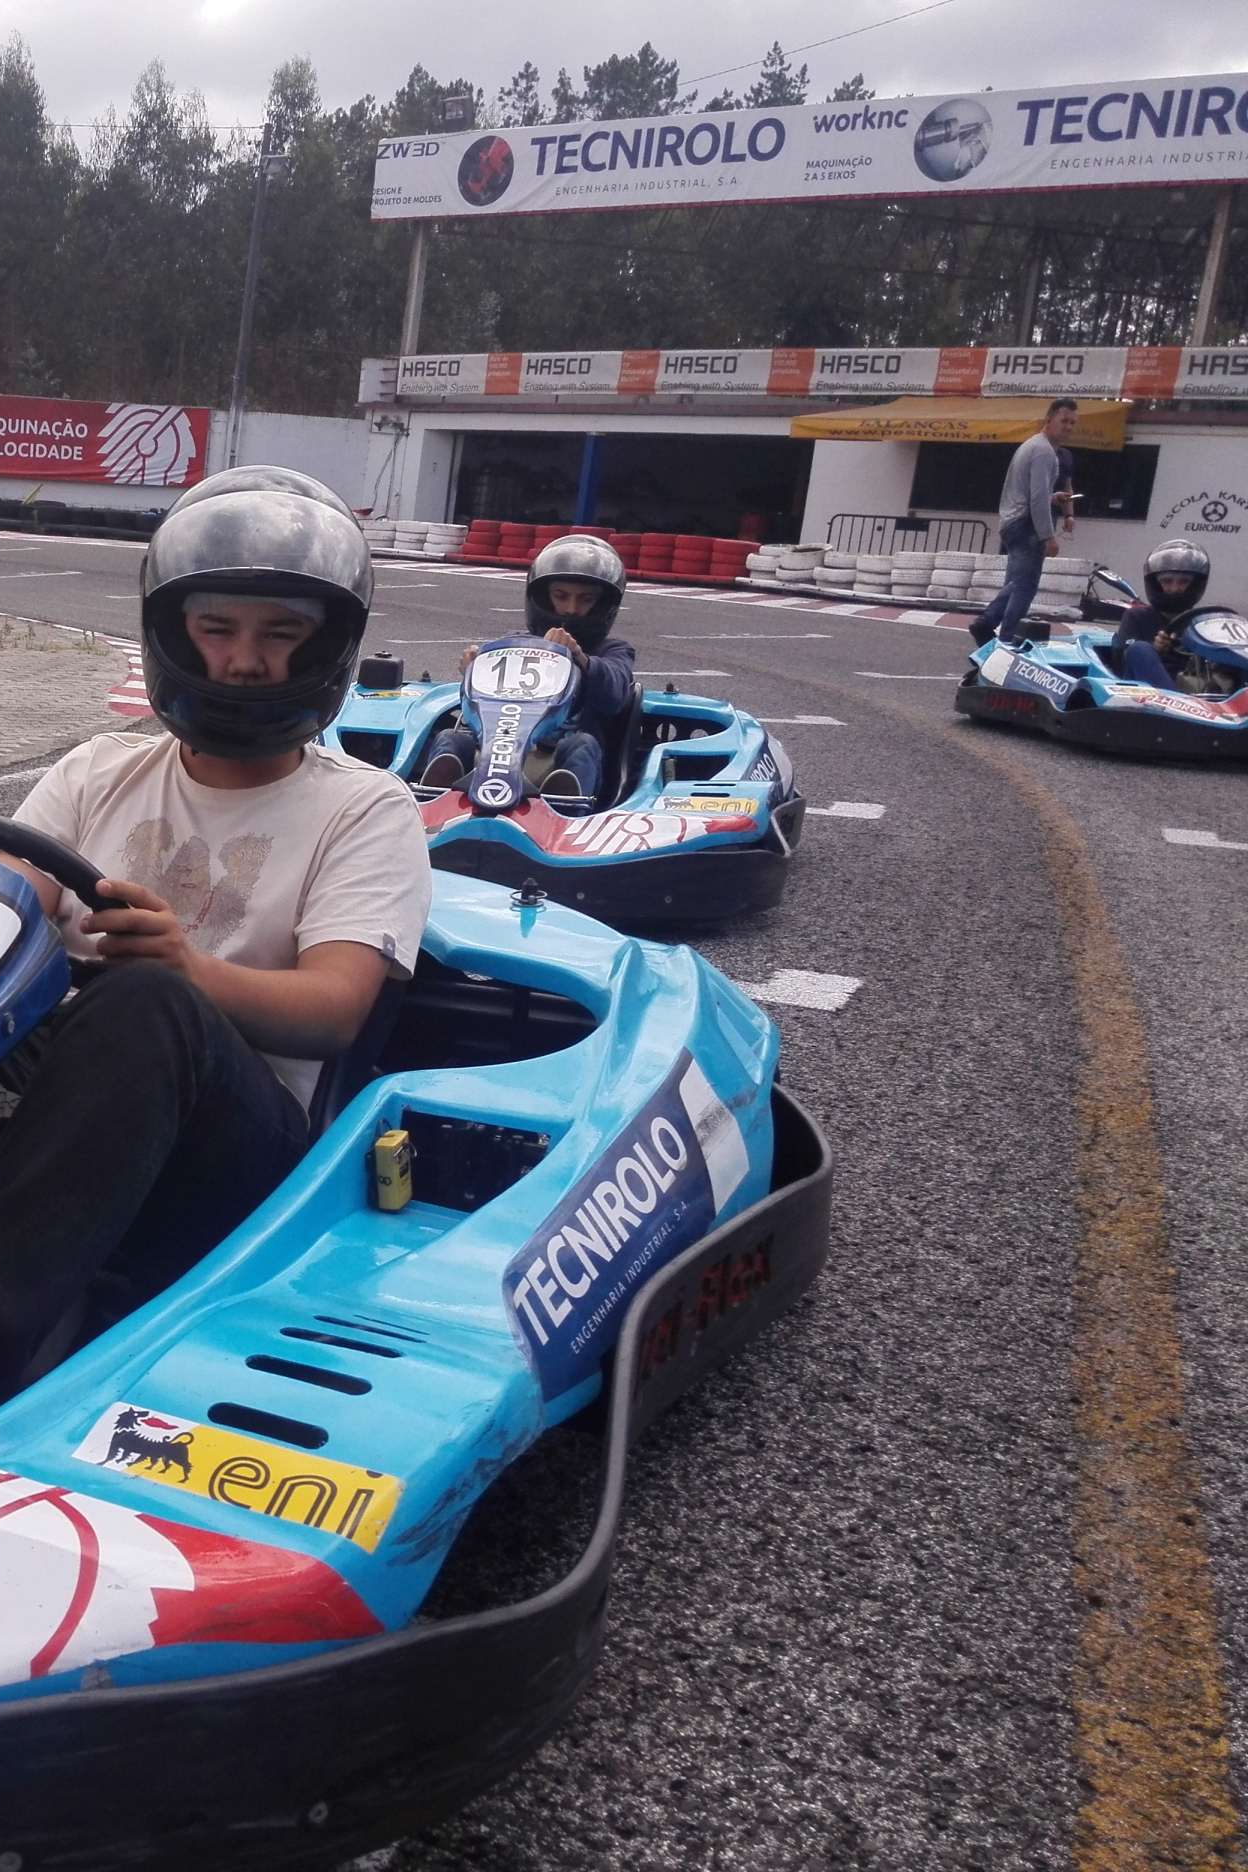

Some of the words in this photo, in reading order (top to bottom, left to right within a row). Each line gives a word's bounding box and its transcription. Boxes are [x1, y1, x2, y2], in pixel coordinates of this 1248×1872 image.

[813, 105, 909, 133] worknc
[530, 118, 786, 176] TECNIROLO
[805, 155, 873, 170] MAQUINAÇÃO
[1050, 155, 1153, 169] ENGENHARIA
[1162, 151, 1248, 165] INDUSTRI
[804, 172, 811, 181] 2
[811, 172, 818, 181] A
[827, 170, 857, 180] EIXOS
[413, 194, 443, 204] MOLDES
[555, 183, 629, 196] ENGENHARIA
[402, 360, 461, 377] HASCO
[526, 358, 592, 375] HASCO
[664, 356, 738, 374] HASCO
[820, 355, 902, 374] HASCO
[992, 354, 1084, 375] HASCO
[1160, 491, 1209, 529] ESCOLA
[1184, 522, 1242, 534] EUROINDY
[487, 649, 559, 660] EUROINDY
[491, 656, 541, 695] 15
[1014, 660, 1070, 696] TECNIROLO
[487, 704, 522, 777] TECNIROLO
[512, 1116, 688, 1346] TECNIROLO
[570, 1280, 627, 1355] ENGENHARIA
[208, 1456, 384, 1540] eni
